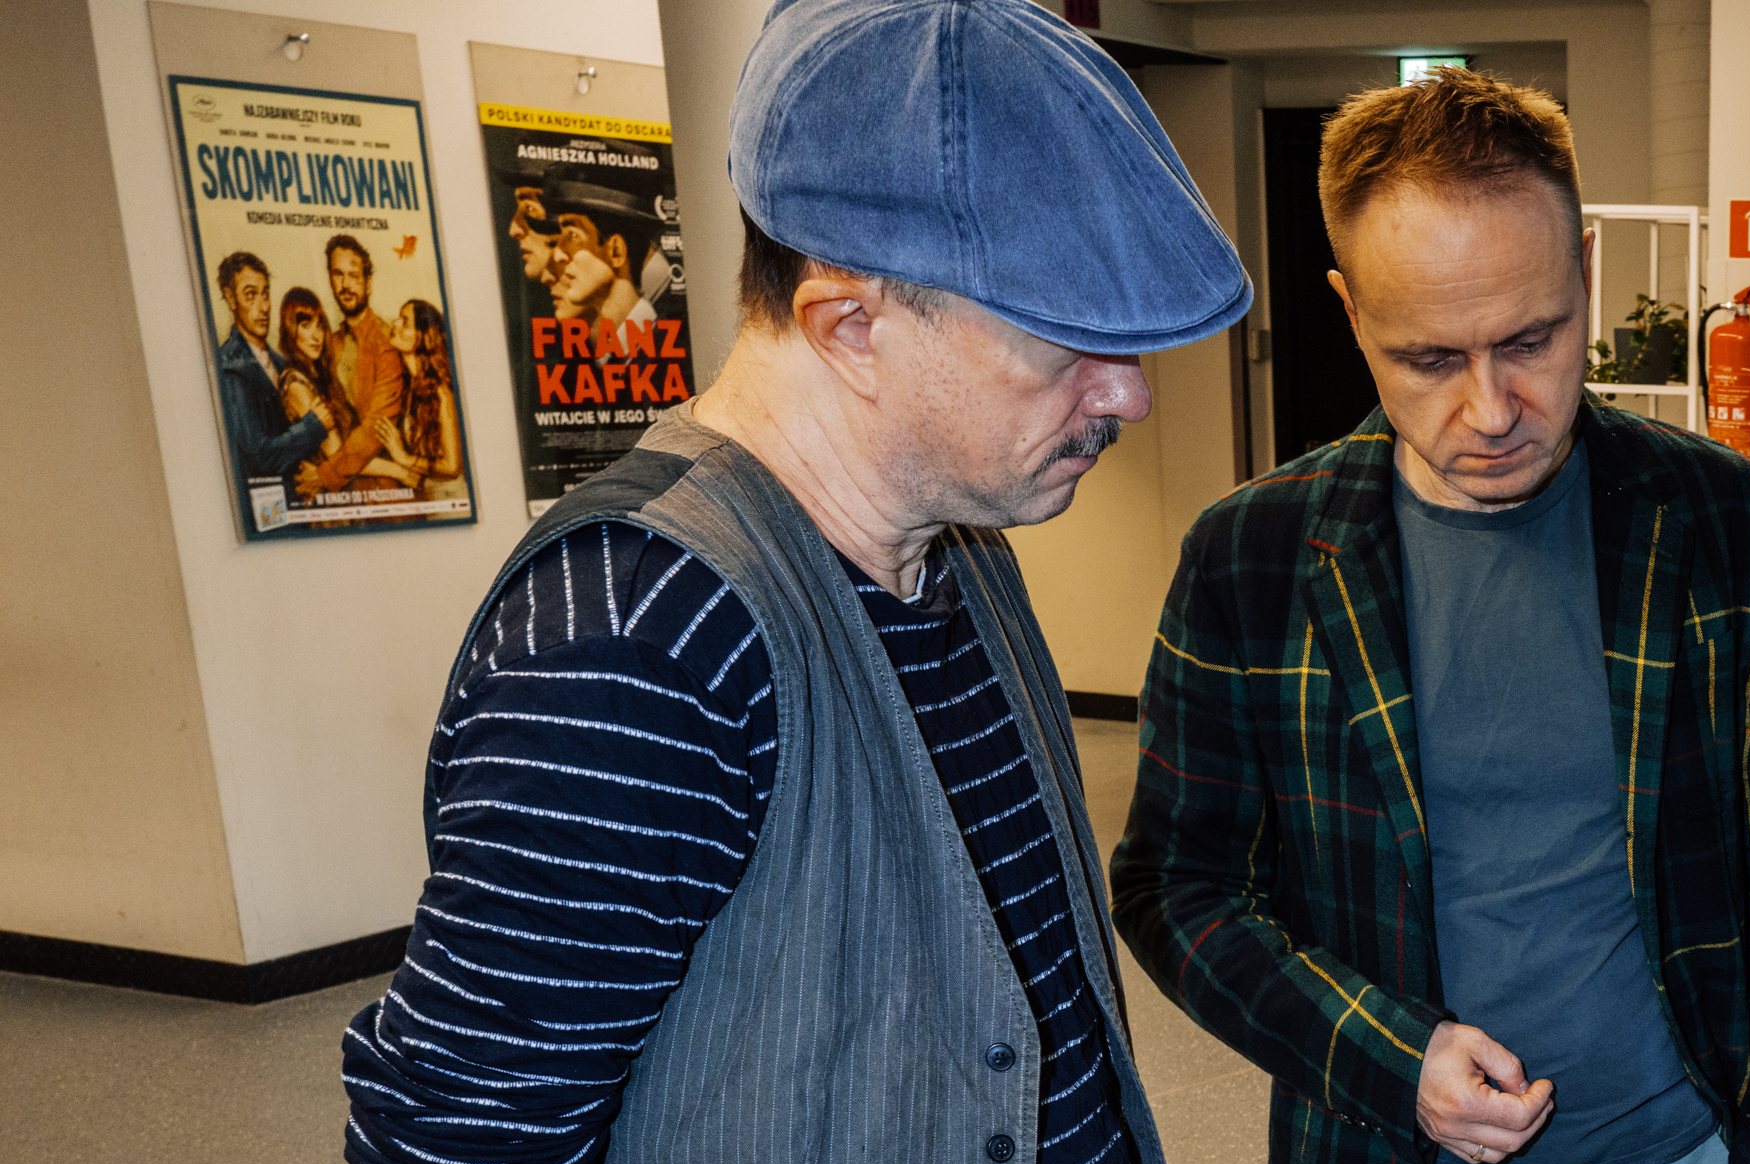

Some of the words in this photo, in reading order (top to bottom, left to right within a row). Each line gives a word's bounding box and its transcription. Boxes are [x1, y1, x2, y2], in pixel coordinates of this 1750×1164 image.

[320, 110, 340, 125] FILM
[487, 107, 535, 124] POLSKI
[538, 113, 602, 131] KANDYDAT
[605, 121, 622, 133] DO
[626, 122, 672, 138] OSCARA
[516, 144, 597, 166] AGNIESZKA
[598, 151, 660, 171] HOLLAND
[197, 143, 420, 212] SKOMPLIKOWANI
[246, 210, 282, 225] KOMEDIA
[334, 215, 390, 231] ROMANTYCZNA
[531, 317, 686, 359] FRANZ
[536, 363, 691, 405] KAFKA
[534, 410, 596, 427] WITAJCIE
[596, 410, 611, 424] W
[614, 409, 646, 424] JEGO
